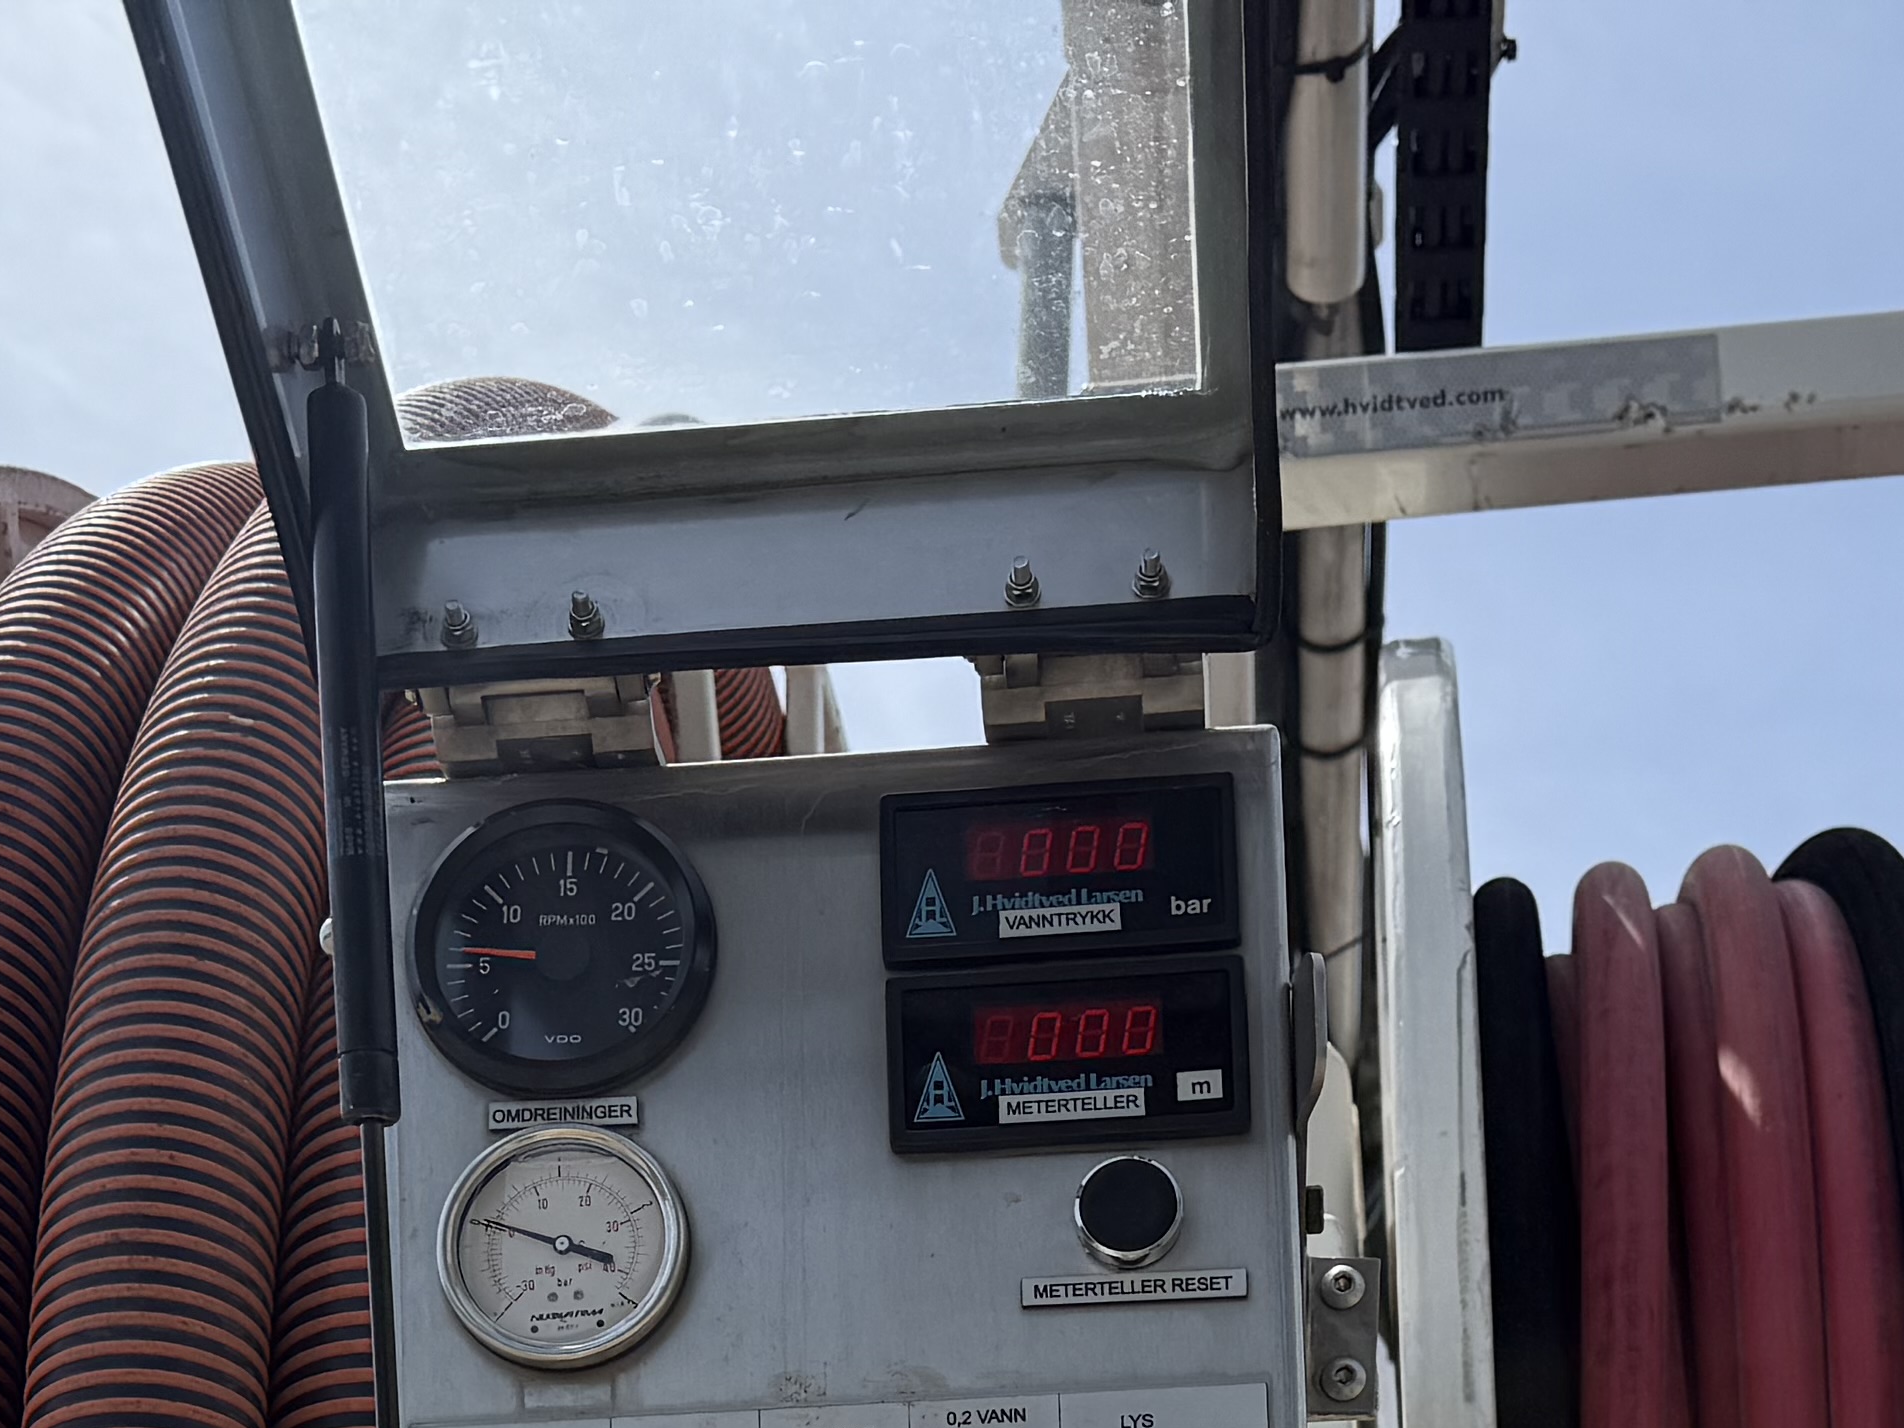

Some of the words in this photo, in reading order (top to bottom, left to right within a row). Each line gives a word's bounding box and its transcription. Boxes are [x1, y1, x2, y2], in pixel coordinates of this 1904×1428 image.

[1280, 388, 1505, 421] www.hvidtved.com
[559, 878, 577, 897] 15
[1081, 887, 1144, 904] Larsen
[502, 905, 521, 924] 10
[610, 902, 636, 921] 20
[1170, 895, 1212, 916] bar
[1005, 909, 1115, 930] VANNTRYKK
[479, 957, 491, 975] 5
[631, 953, 656, 971] 25
[498, 1011, 510, 1029] 0
[618, 1008, 643, 1027] 30
[544, 1034, 582, 1044] VDO
[1090, 1072, 1153, 1089] Larsen
[1192, 1081, 1211, 1094] m
[1007, 1095, 1139, 1115] METERTELLER
[493, 1104, 634, 1126] OMDREININGER
[537, 1198, 549, 1210] 10
[578, 1195, 592, 1207] 20
[606, 1220, 619, 1233] 30
[1034, 1279, 1167, 1299] METERTELLER
[1172, 1276, 1232, 1292] RESET
[947, 1411, 971, 1428] 0,2
[977, 1408, 1026, 1424] VANN
[1121, 1414, 1153, 1428] LYS
